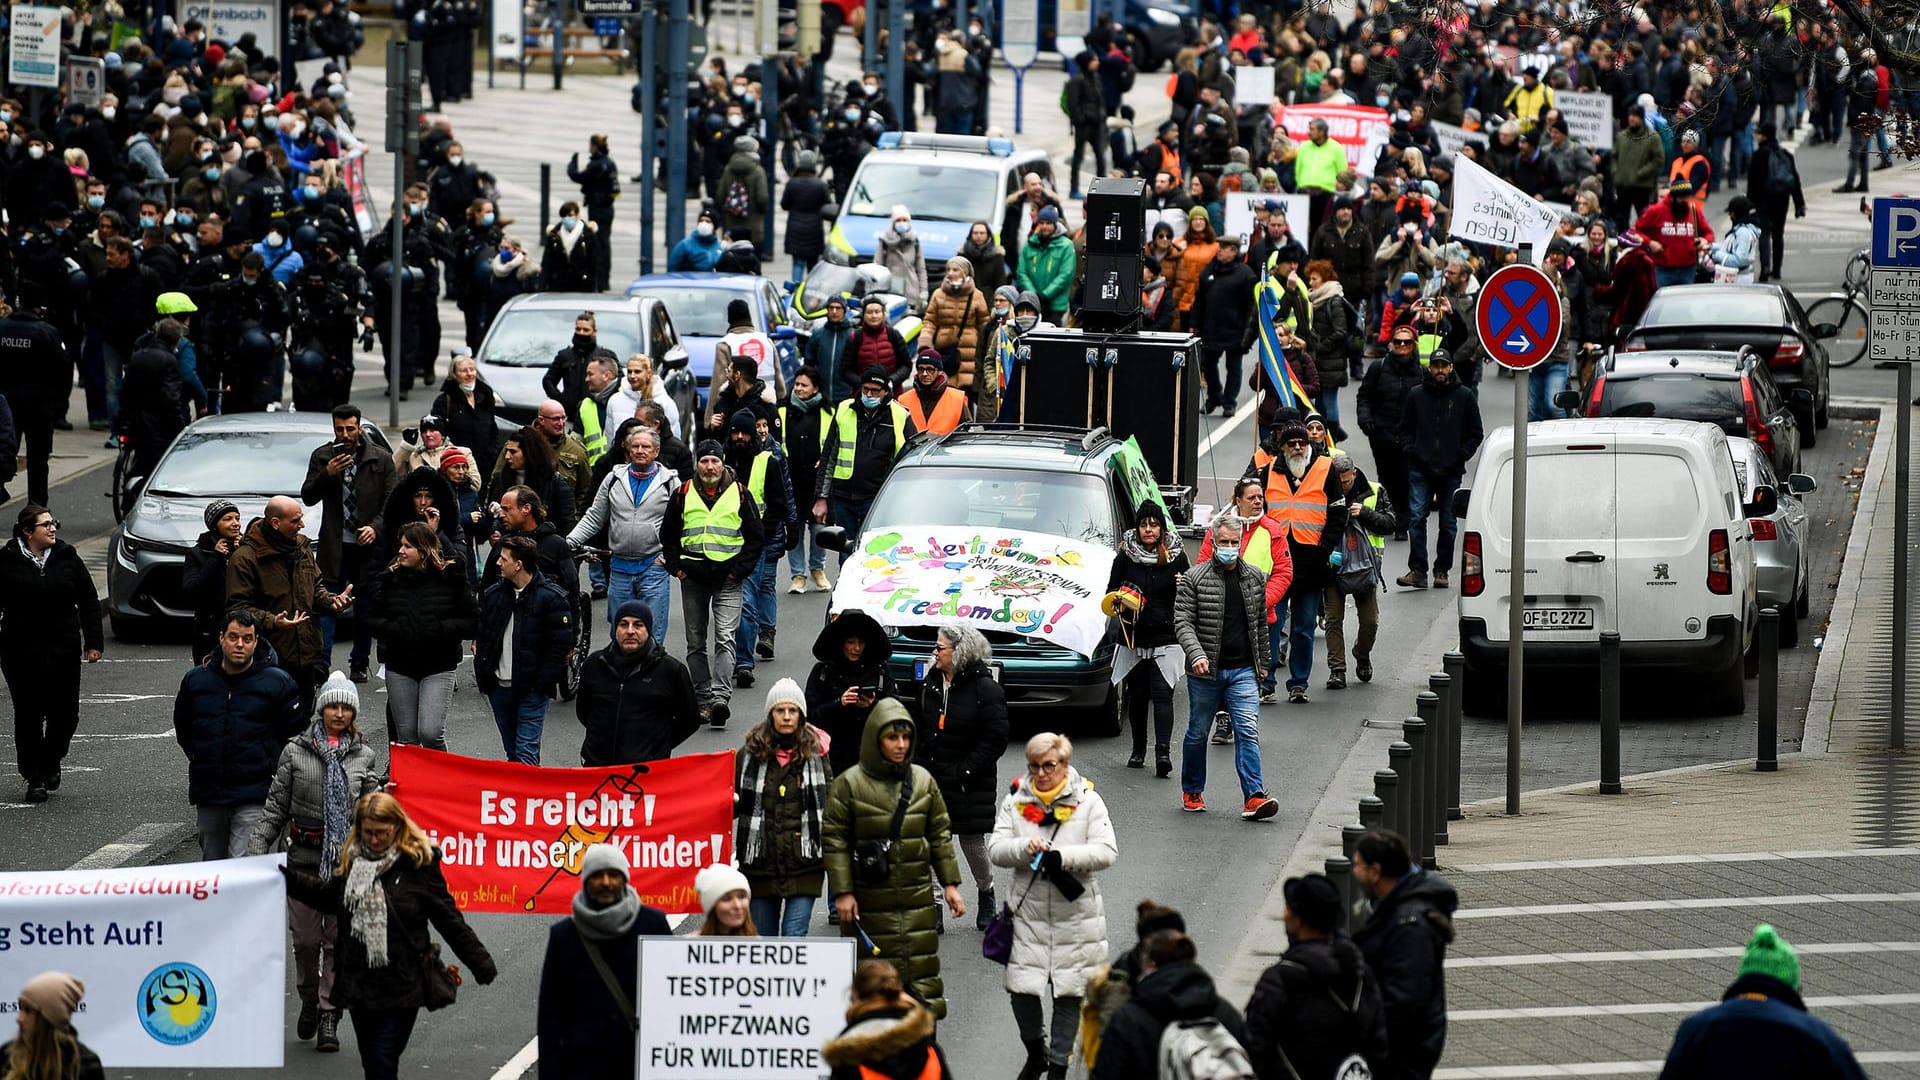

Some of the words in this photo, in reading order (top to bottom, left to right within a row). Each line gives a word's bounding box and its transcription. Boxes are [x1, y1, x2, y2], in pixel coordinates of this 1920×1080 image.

[1885, 278, 1903, 287] nur
[1907, 277, 1920, 288] mi
[1874, 289, 1920, 301] Parksch
[1877, 315, 1890, 325] bis
[1893, 315, 1897, 326] 1
[1900, 315, 1920, 327] Stun
[1, 336, 32, 349] POLIZEI
[1872, 330, 1900, 341] Mo-Fr
[1905, 331, 1920, 341] 8-1
[1872, 344, 1887, 355] Sa
[1905, 345, 1920, 356] 8-1
[883, 588, 1075, 634] Freedomday!
[1523, 611, 1540, 625] OF
[1549, 611, 1559, 625] C
[1561, 611, 1586, 625] 272
[480, 790, 517, 826] Es
[496, 838, 586, 869] unser
[20, 921, 94, 945] Steht
[104, 920, 163, 945] Auf!
[687, 945, 808, 965] NILPFERDE
[667, 976, 806, 997] TESTPOSITIV
[680, 1015, 811, 1036] IMPFZWANG
[651, 1042, 694, 1068] FÜR
[701, 1048, 819, 1068] WILDTIERE
